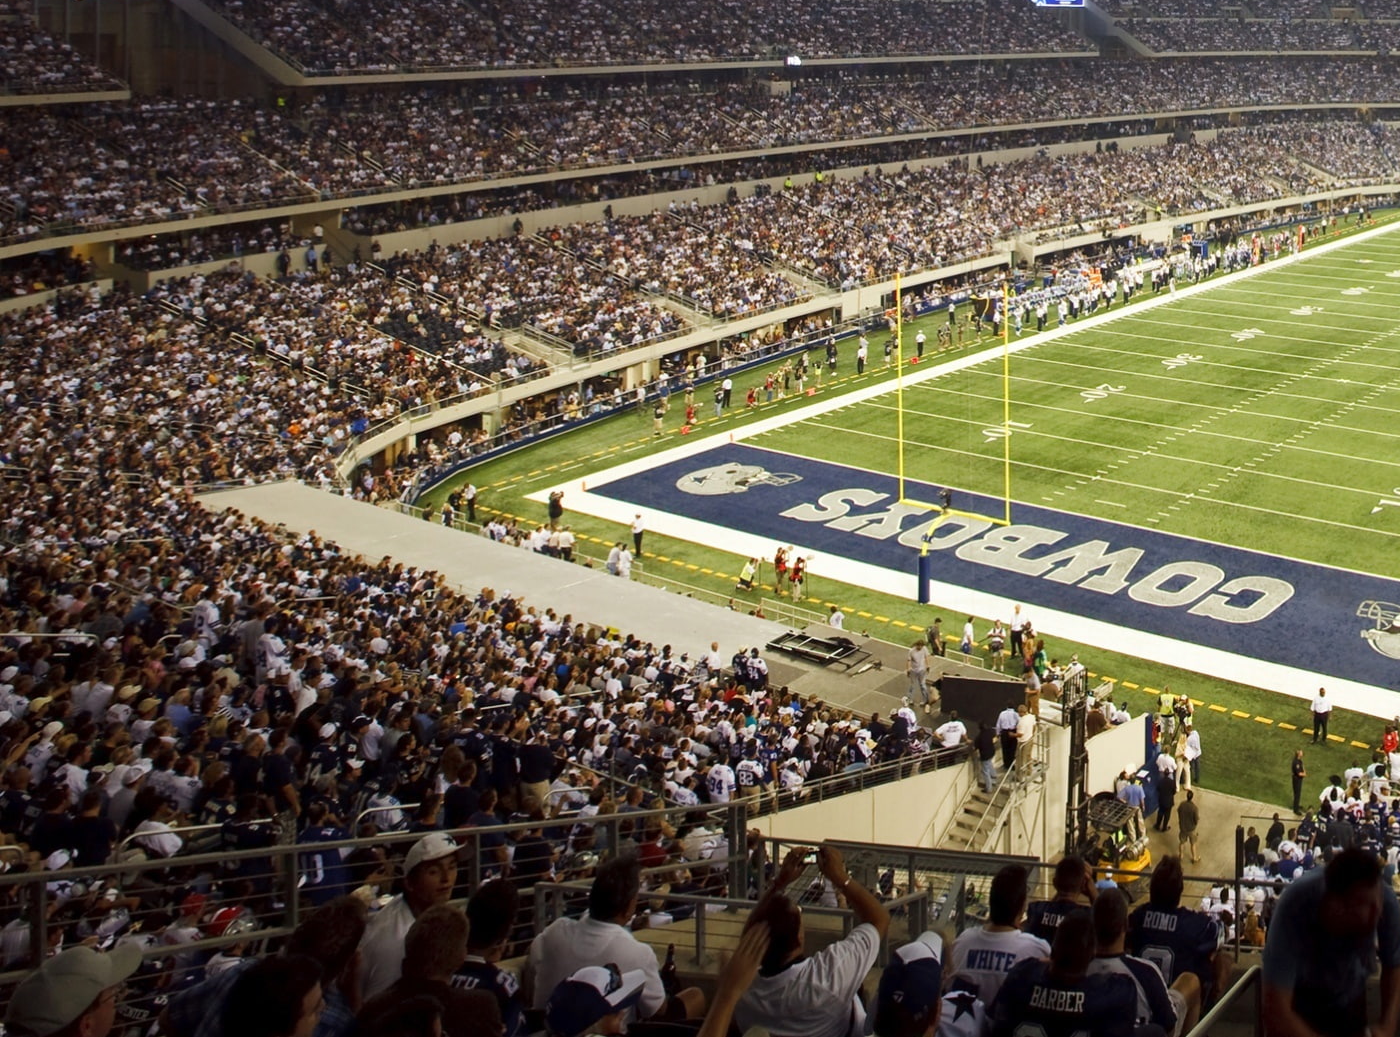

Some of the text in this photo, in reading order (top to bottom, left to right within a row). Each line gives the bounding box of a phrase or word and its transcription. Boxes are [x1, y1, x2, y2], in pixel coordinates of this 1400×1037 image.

[778, 488, 1296, 625] COWBOYS
[1041, 912, 1065, 927] ROM
[1143, 910, 1178, 932] ROMO
[966, 948, 1017, 973] WHITE
[1029, 985, 1086, 1013] BARBER
